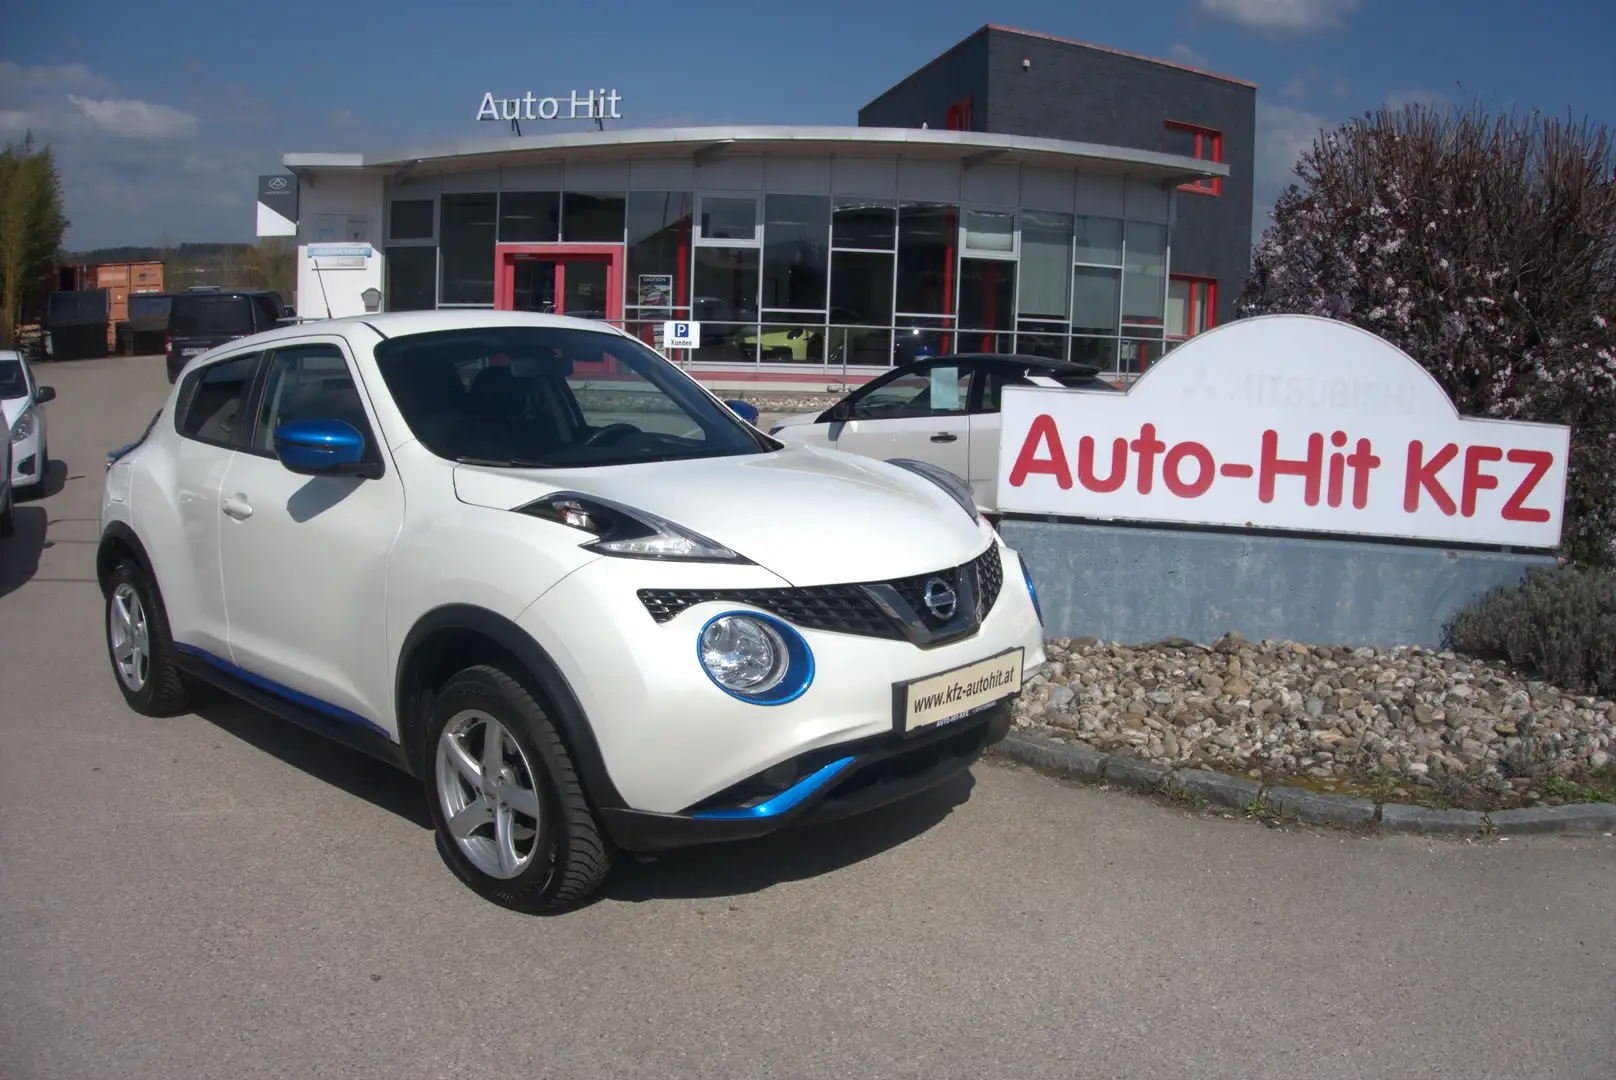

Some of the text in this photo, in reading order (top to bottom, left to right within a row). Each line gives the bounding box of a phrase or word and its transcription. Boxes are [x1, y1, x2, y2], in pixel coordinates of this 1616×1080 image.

[476, 88, 622, 120] Auto Hit
[677, 324, 686, 337] P
[1009, 413, 1554, 524] Auto-Hit KFZ
[914, 665, 1014, 714] www.kfz-autohit.at
